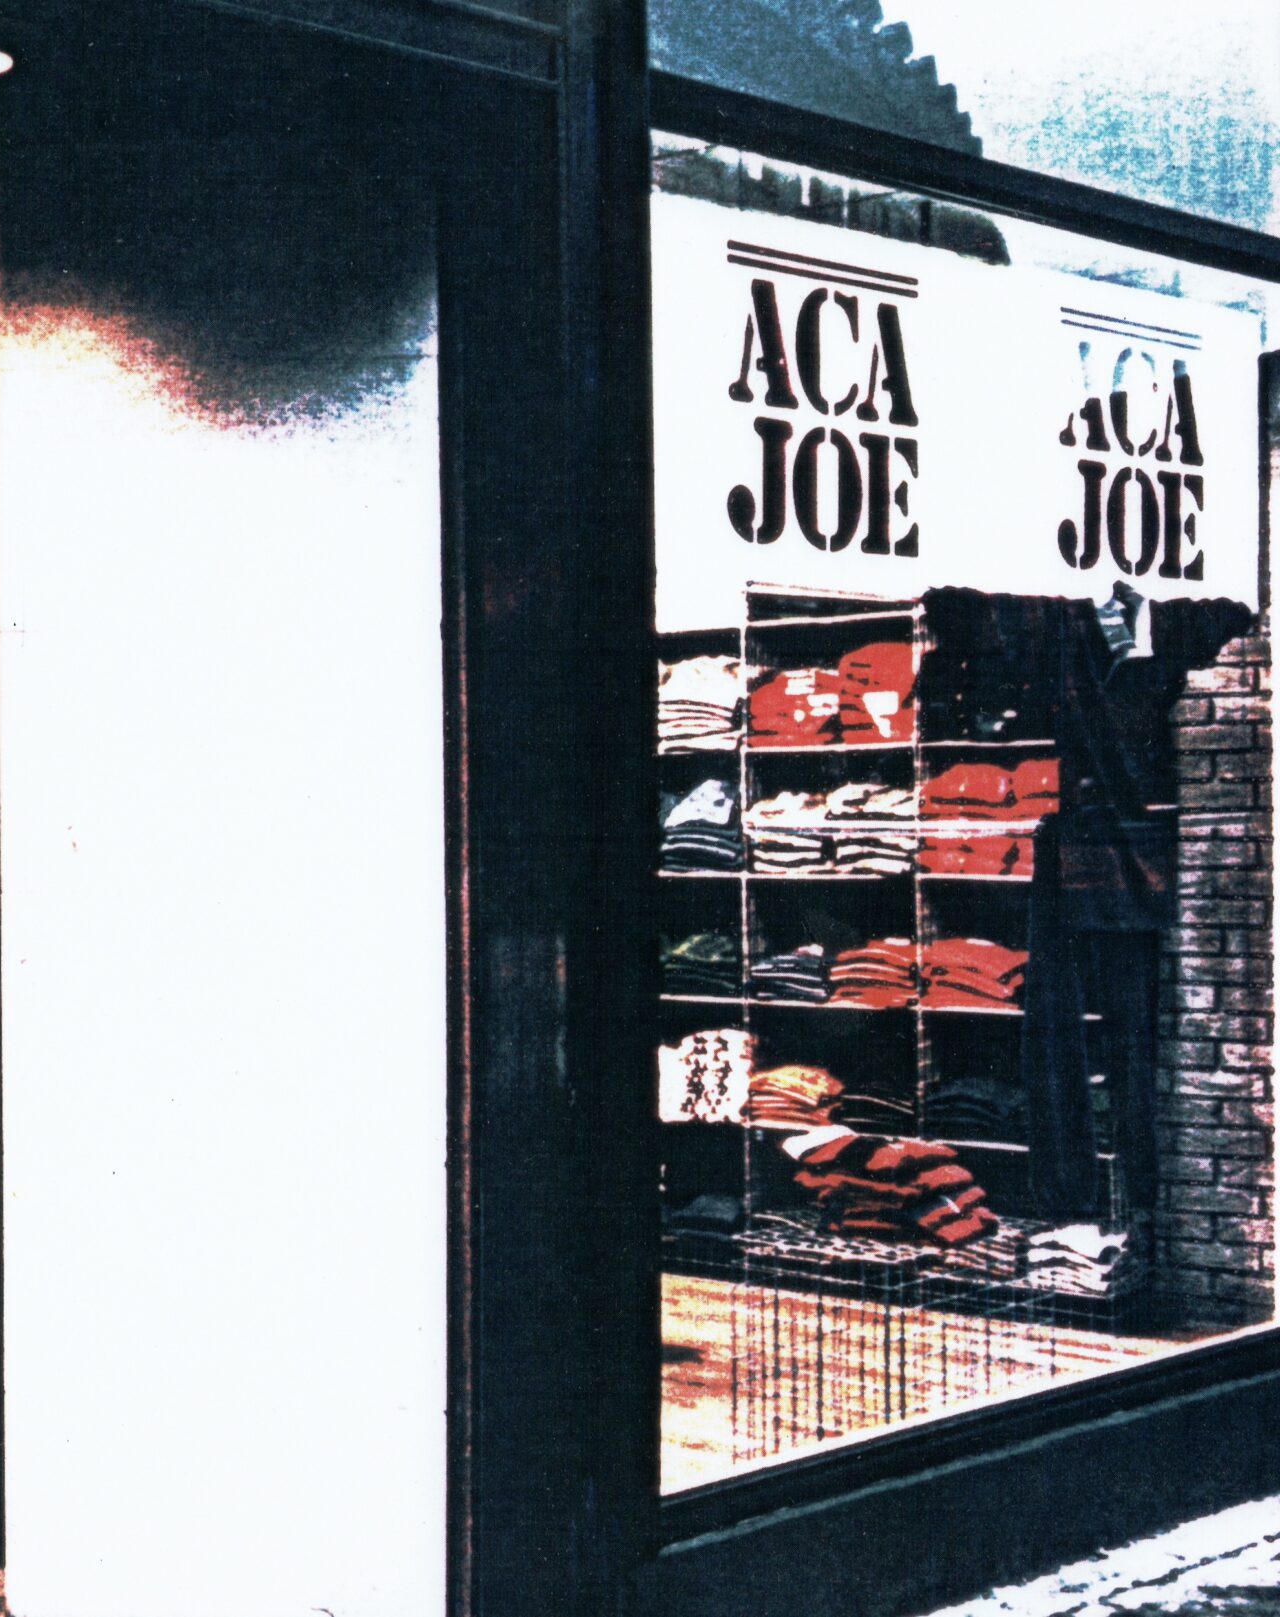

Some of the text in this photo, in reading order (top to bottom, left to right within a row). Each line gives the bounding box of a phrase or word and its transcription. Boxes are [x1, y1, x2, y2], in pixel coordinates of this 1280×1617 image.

[728, 279, 919, 427] ACA
[1059, 341, 1204, 467] ACA
[727, 416, 919, 557] JOE
[1057, 459, 1204, 581] JOE
